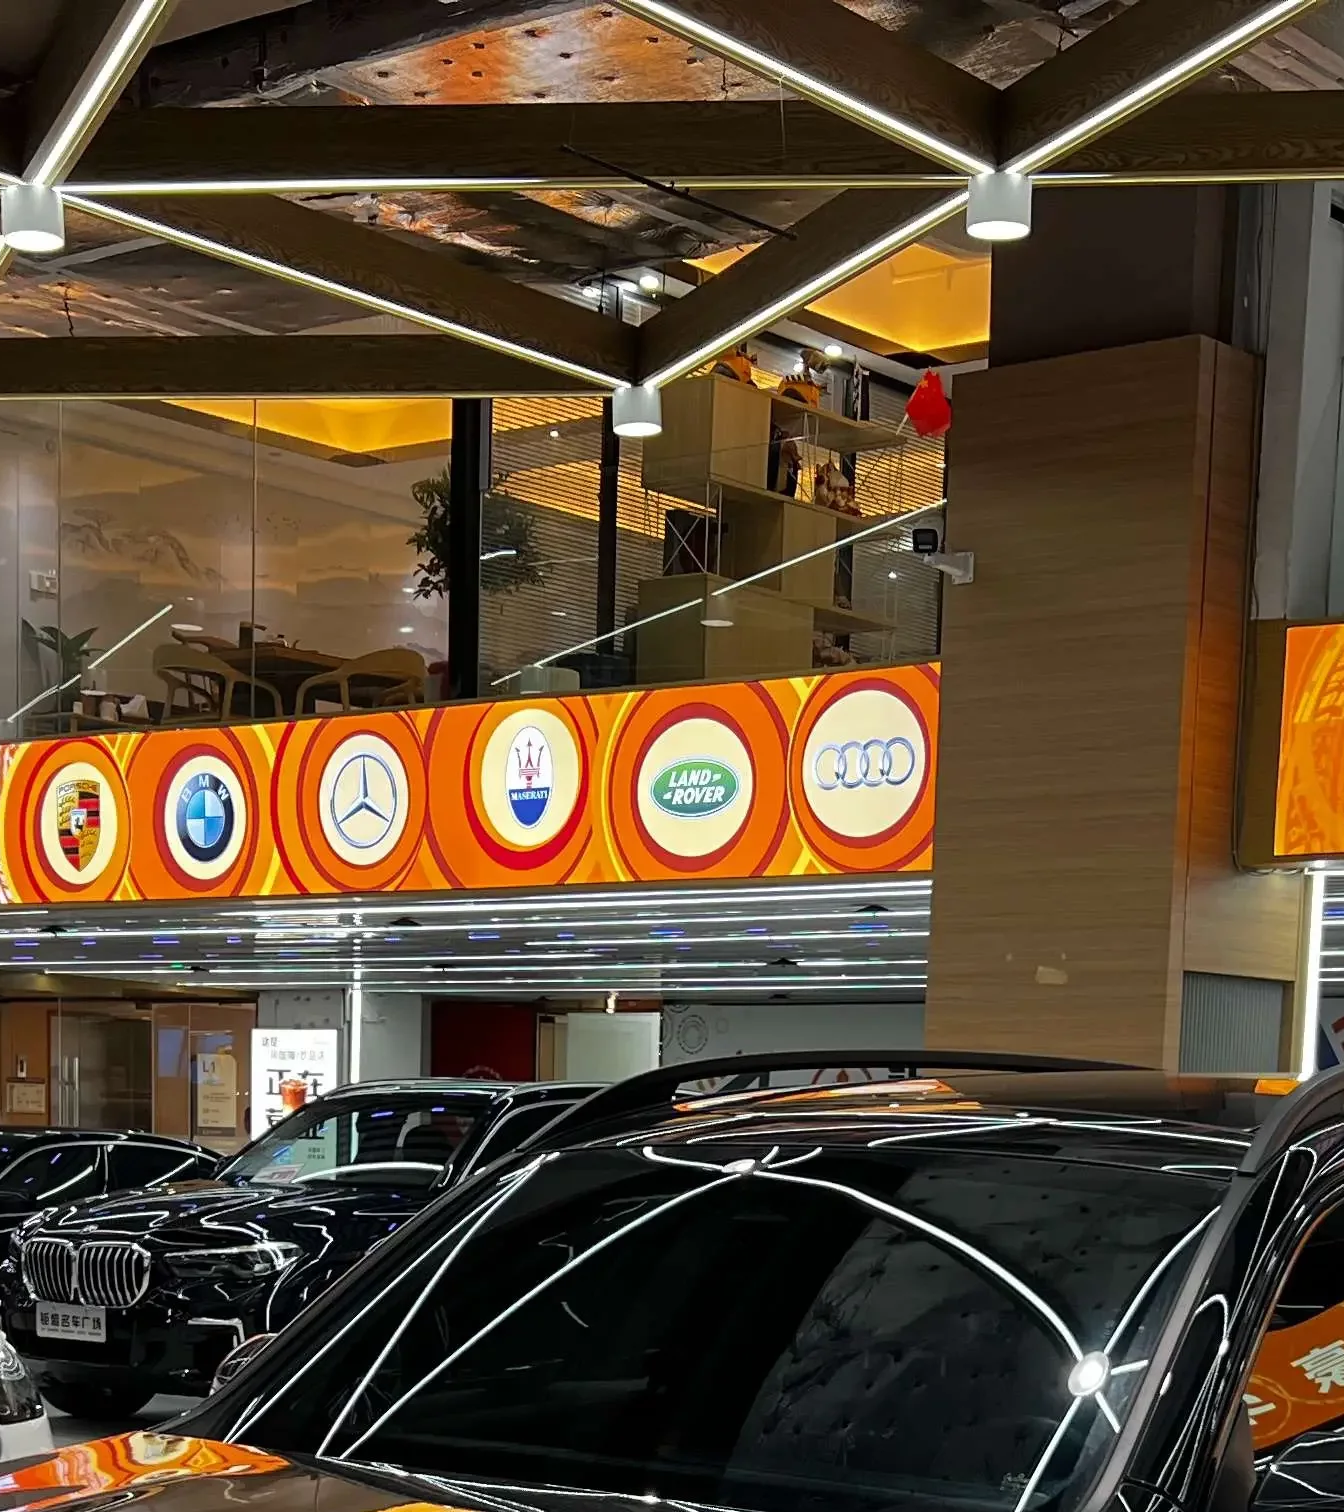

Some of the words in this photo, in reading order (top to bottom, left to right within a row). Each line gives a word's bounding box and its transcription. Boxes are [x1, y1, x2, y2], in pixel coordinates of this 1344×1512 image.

[668, 768, 711, 788] LAND
[58, 783, 98, 796] PORSCHE
[182, 774, 230, 802] BMW
[510, 789, 547, 801] MASERATI
[672, 786, 725, 805] ROVER
